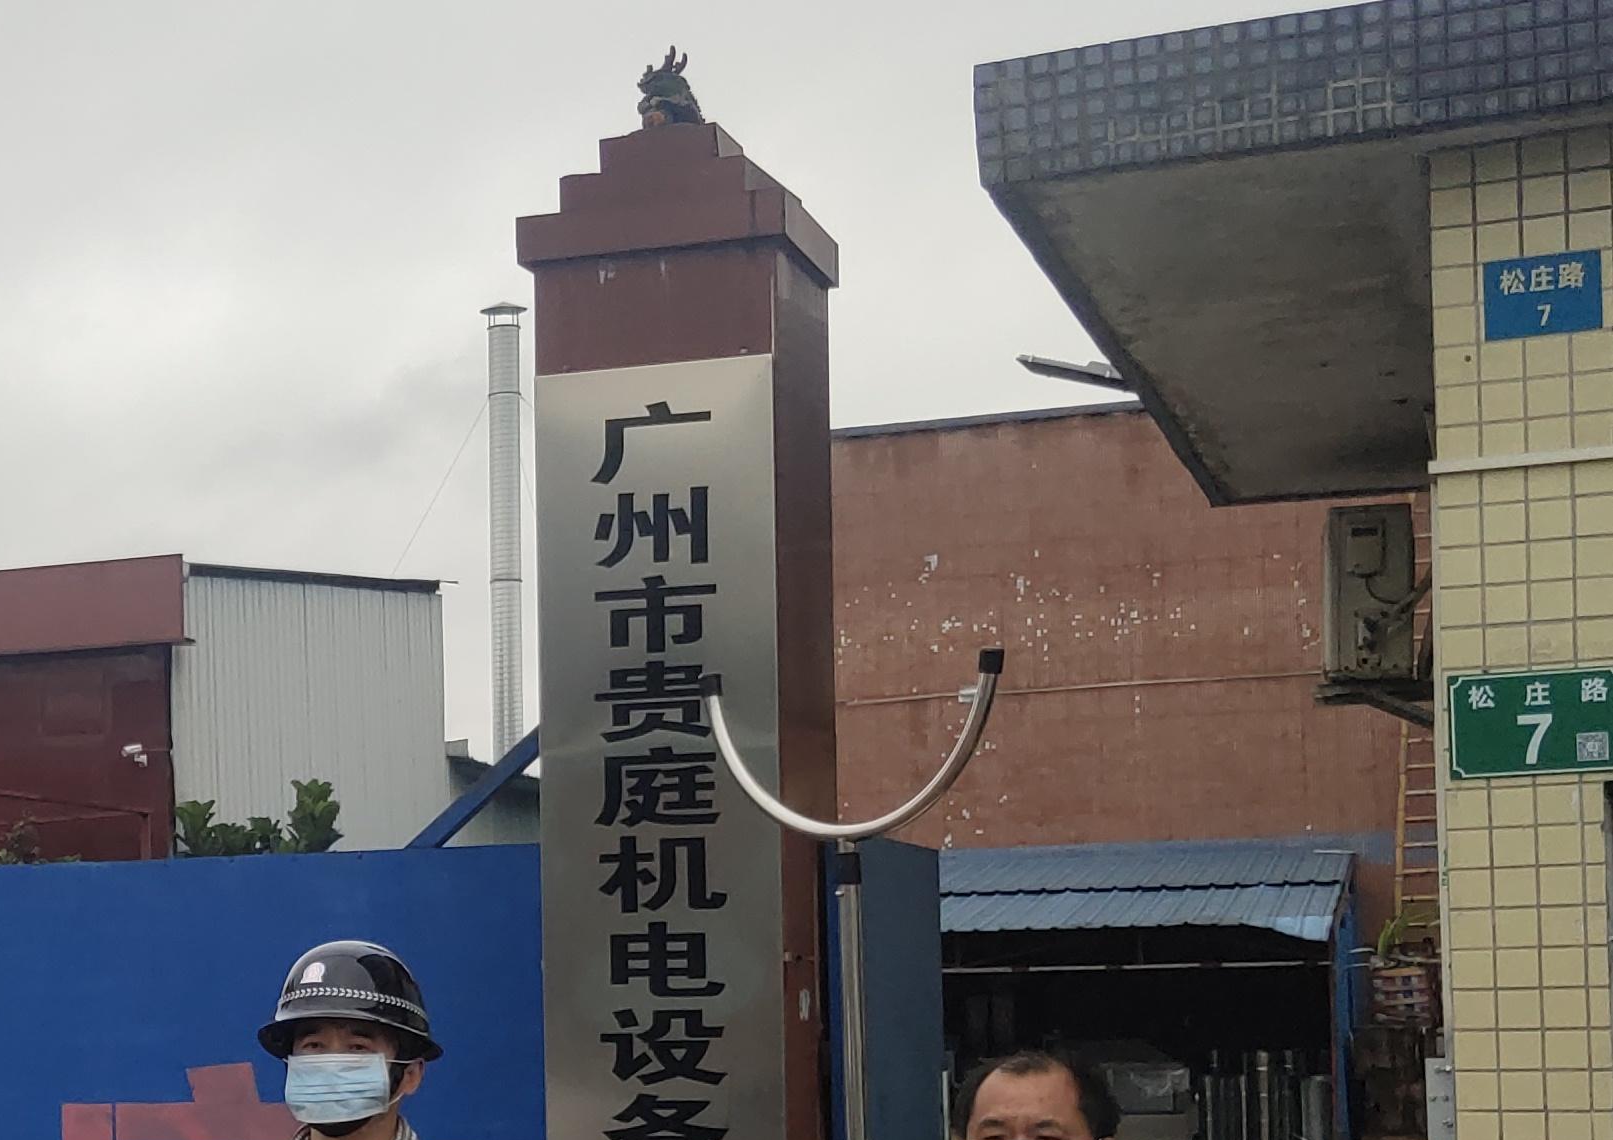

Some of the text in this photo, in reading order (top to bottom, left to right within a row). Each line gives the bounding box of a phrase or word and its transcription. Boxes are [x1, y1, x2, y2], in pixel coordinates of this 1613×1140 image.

[1499, 262, 1585, 296] 松庄路
[1537, 303, 1552, 327] 7
[1468, 677, 1609, 711] 松庄路
[1516, 713, 1553, 765] 7
